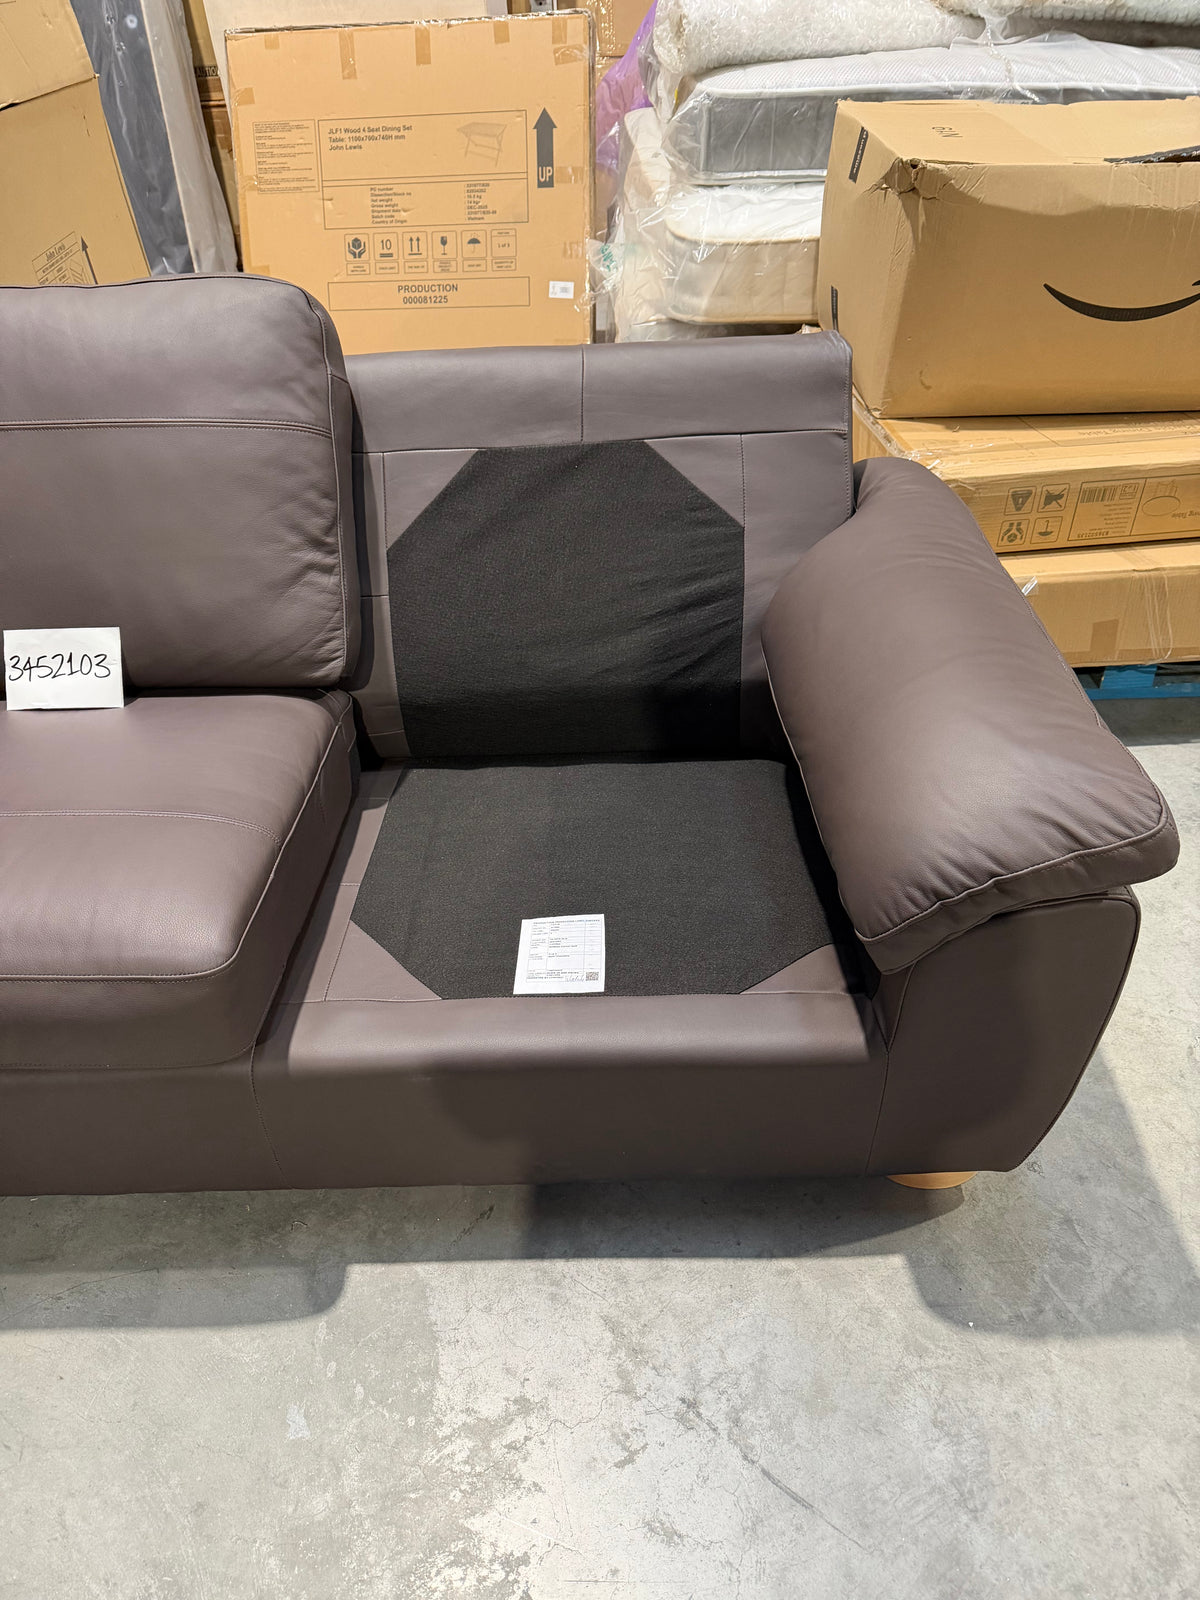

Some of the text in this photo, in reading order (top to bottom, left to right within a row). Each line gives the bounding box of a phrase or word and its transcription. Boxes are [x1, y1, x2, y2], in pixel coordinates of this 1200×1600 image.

[538, 166, 553, 182] UP
[381, 239, 392, 250] 10
[397, 284, 458, 294] PRODUCTION
[402, 296, 448, 304] 000081225
[8, 652, 110, 682] 3452103
